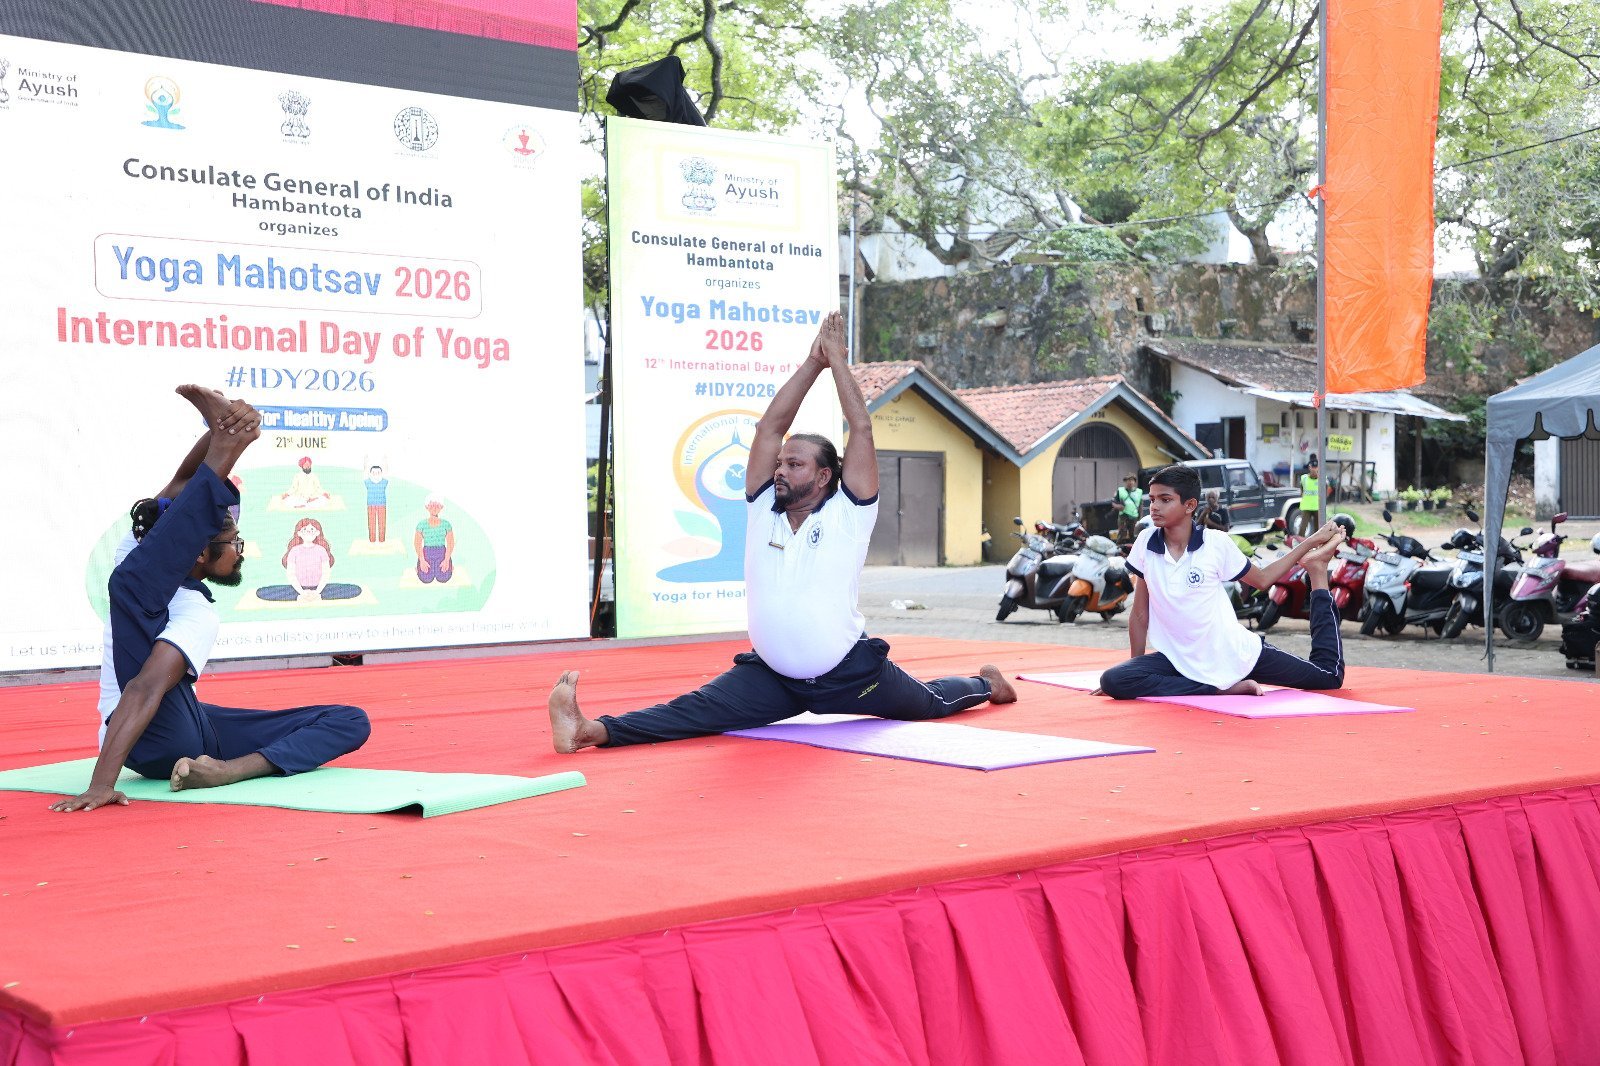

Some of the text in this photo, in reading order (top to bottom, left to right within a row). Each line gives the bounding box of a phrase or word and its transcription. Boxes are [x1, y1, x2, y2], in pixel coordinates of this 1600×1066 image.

[18, 67, 77, 83] Ministry of
[18, 78, 78, 98] Ayush
[123, 157, 453, 208] Consulate General of India
[724, 173, 778, 186] Ministry of
[725, 183, 779, 200] Ayush
[232, 192, 362, 219] Hambantota
[258, 221, 339, 237] organizes
[631, 230, 822, 258] Consulate General of India
[686, 252, 774, 271] Hambantota
[112, 245, 471, 301] Yoga Mahotsav 2026
[705, 277, 761, 291] organizes
[640, 295, 820, 325] Yoga Mahotsav
[57, 307, 510, 369] International Day of Yoga
[705, 329, 764, 352] 2026
[669, 358, 750, 372] International
[755, 361, 775, 375] Day
[780, 363, 791, 373] of
[225, 365, 375, 393] #IDY2026
[695, 382, 776, 398] #IDY2026
[259, 409, 383, 431] for Healthy Ageing
[297, 437, 327, 449] JUNE
[684, 416, 738, 466] International
[652, 588, 746, 604] Yoga for Heal
[266, 631, 313, 643] holistic
[314, 630, 362, 645] journey
[366, 628, 379, 638] to
[10, 645, 34, 657] Let
[40, 645, 58, 656] us
[62, 642, 95, 655] take
